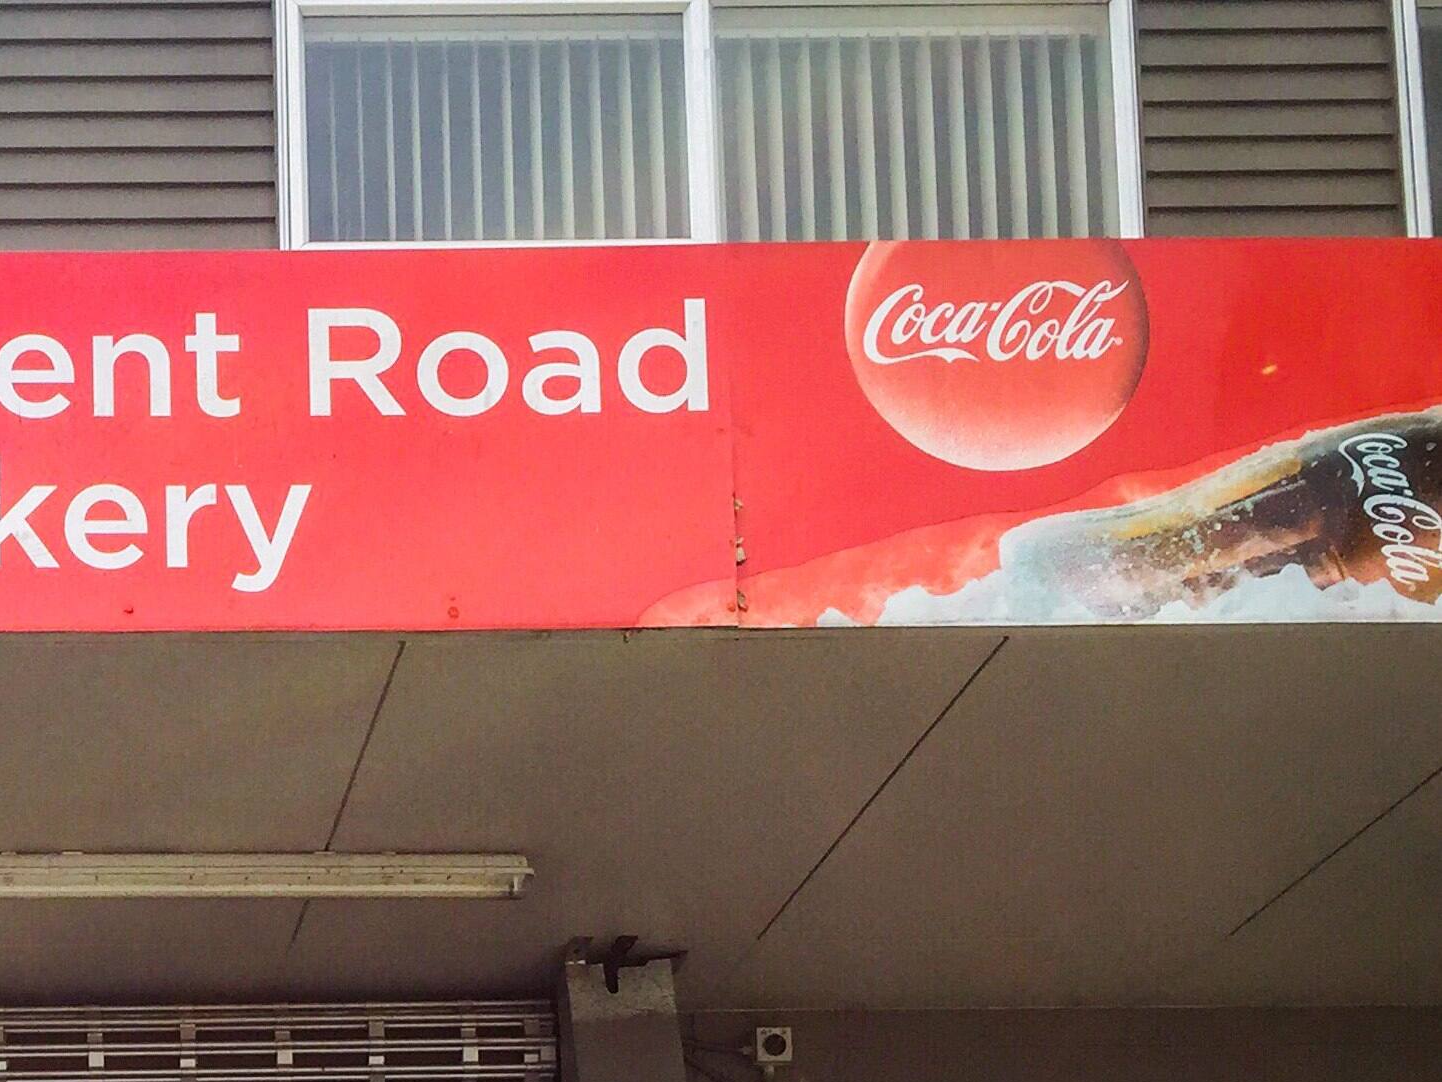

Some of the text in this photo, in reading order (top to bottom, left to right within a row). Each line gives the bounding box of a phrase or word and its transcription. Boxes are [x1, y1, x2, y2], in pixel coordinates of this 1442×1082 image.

[307, 297, 710, 417] Road
[863, 279, 1129, 365] Coca-Cola
[1338, 431, 1442, 590] Coca-Cola
